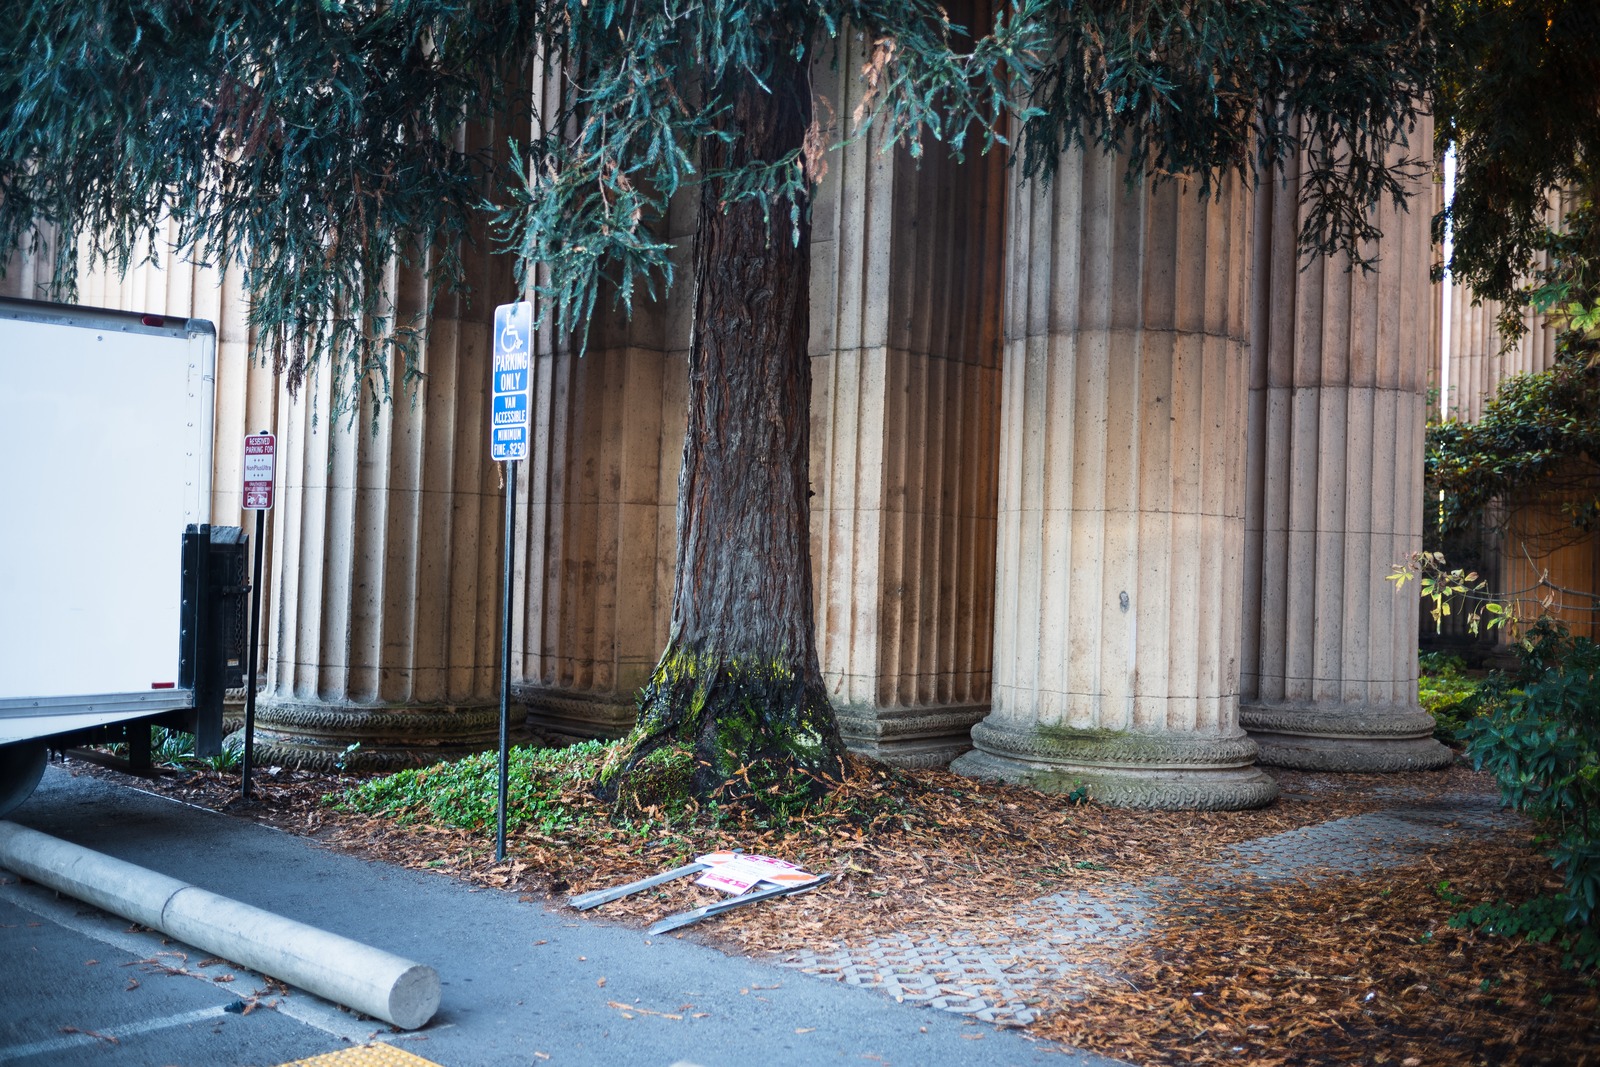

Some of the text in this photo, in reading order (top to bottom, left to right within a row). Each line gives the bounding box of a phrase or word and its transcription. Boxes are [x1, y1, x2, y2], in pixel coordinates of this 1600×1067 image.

[495, 352, 527, 372] PARKING
[501, 372, 521, 391] ONLY
[505, 396, 516, 409] VAN
[495, 410, 526, 423] ACCESSIBLE
[498, 428, 522, 441] MINIMUM
[246, 445, 273, 454] PARKING FOR
[494, 442, 525, 455] FINE $250
